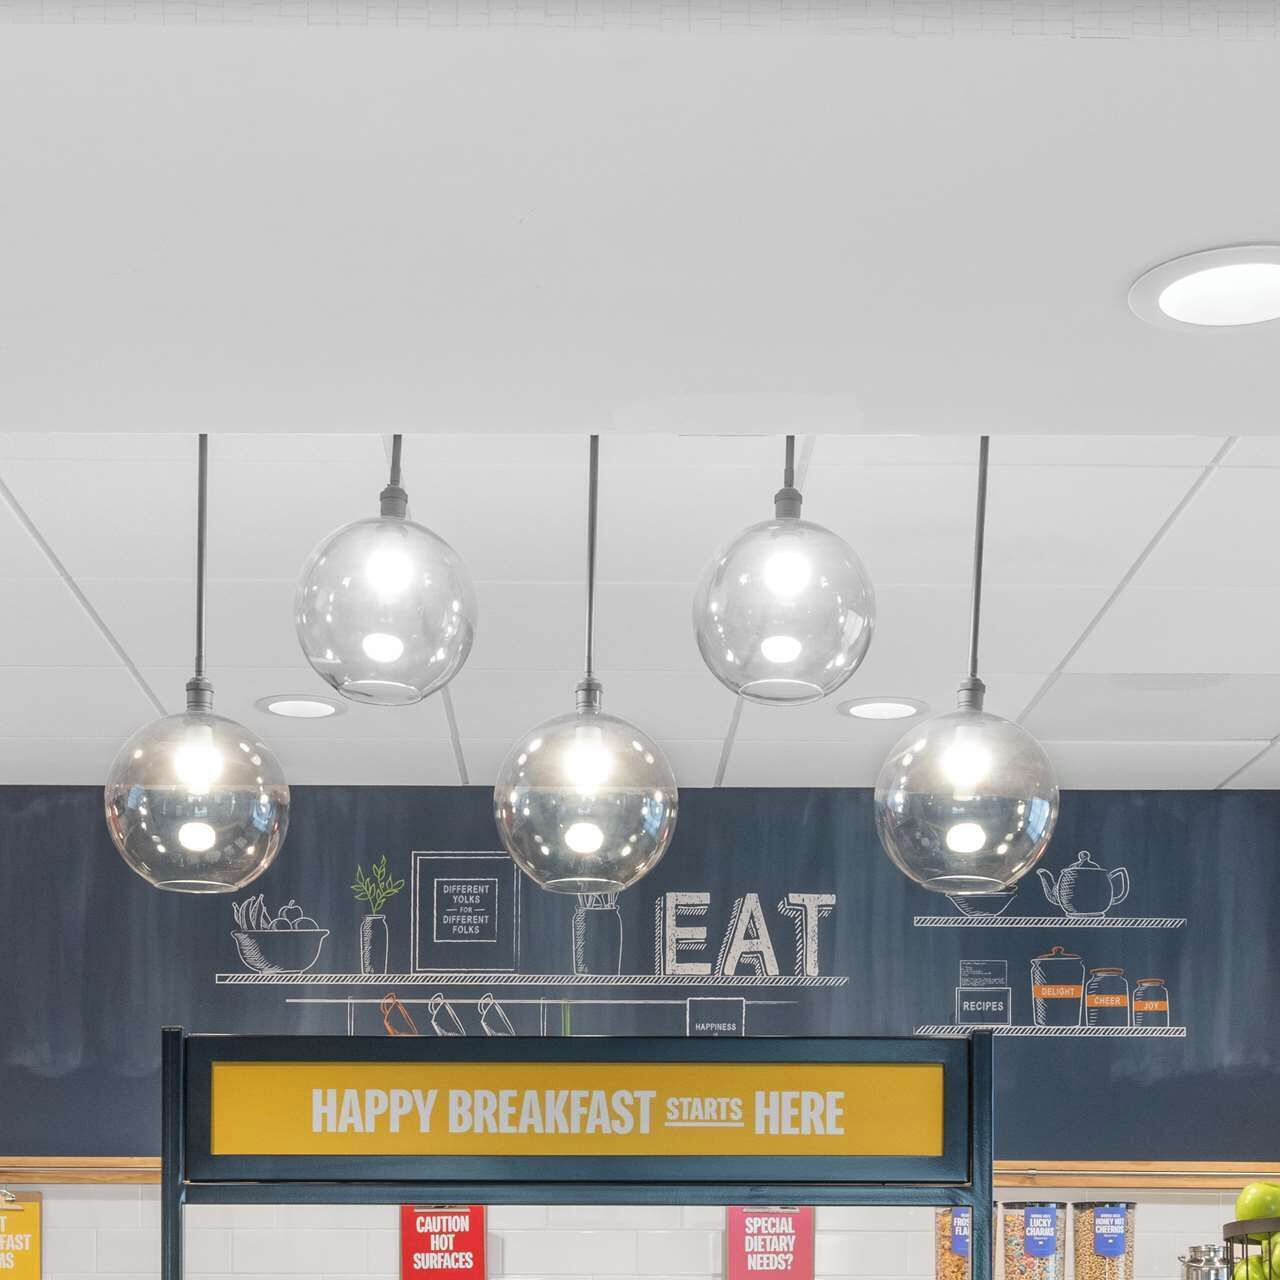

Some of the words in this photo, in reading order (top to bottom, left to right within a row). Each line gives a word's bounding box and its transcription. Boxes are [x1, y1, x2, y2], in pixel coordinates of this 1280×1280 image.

[443, 885, 489, 894] DIFFERENT
[453, 895, 481, 903] YOLKS
[442, 915, 489, 924] DIFFERENT
[452, 925, 480, 934] FOLKS
[656, 892, 837, 976] EAT
[1041, 987, 1075, 996] DELIGHT
[1094, 996, 1121, 1005] CHEER
[963, 1001, 1004, 1011] RECIPES
[1143, 1001, 1159, 1010] JOY
[695, 1023, 737, 1031] HAPPINESS
[311, 1088, 438, 1133] HAPPY
[448, 1089, 657, 1134] BREAKFAST
[666, 1097, 743, 1121] STARTS
[754, 1091, 845, 1135] HERE
[416, 1215, 469, 1233] CAUTION
[745, 1216, 795, 1233] SPECIAL
[1029, 1218, 1051, 1227] LUCKY
[430, 1234, 455, 1251] HOT
[744, 1235, 796, 1252] DIETARY
[413, 1252, 474, 1269] SURFACES
[747, 1253, 793, 1271] NEEDS?
